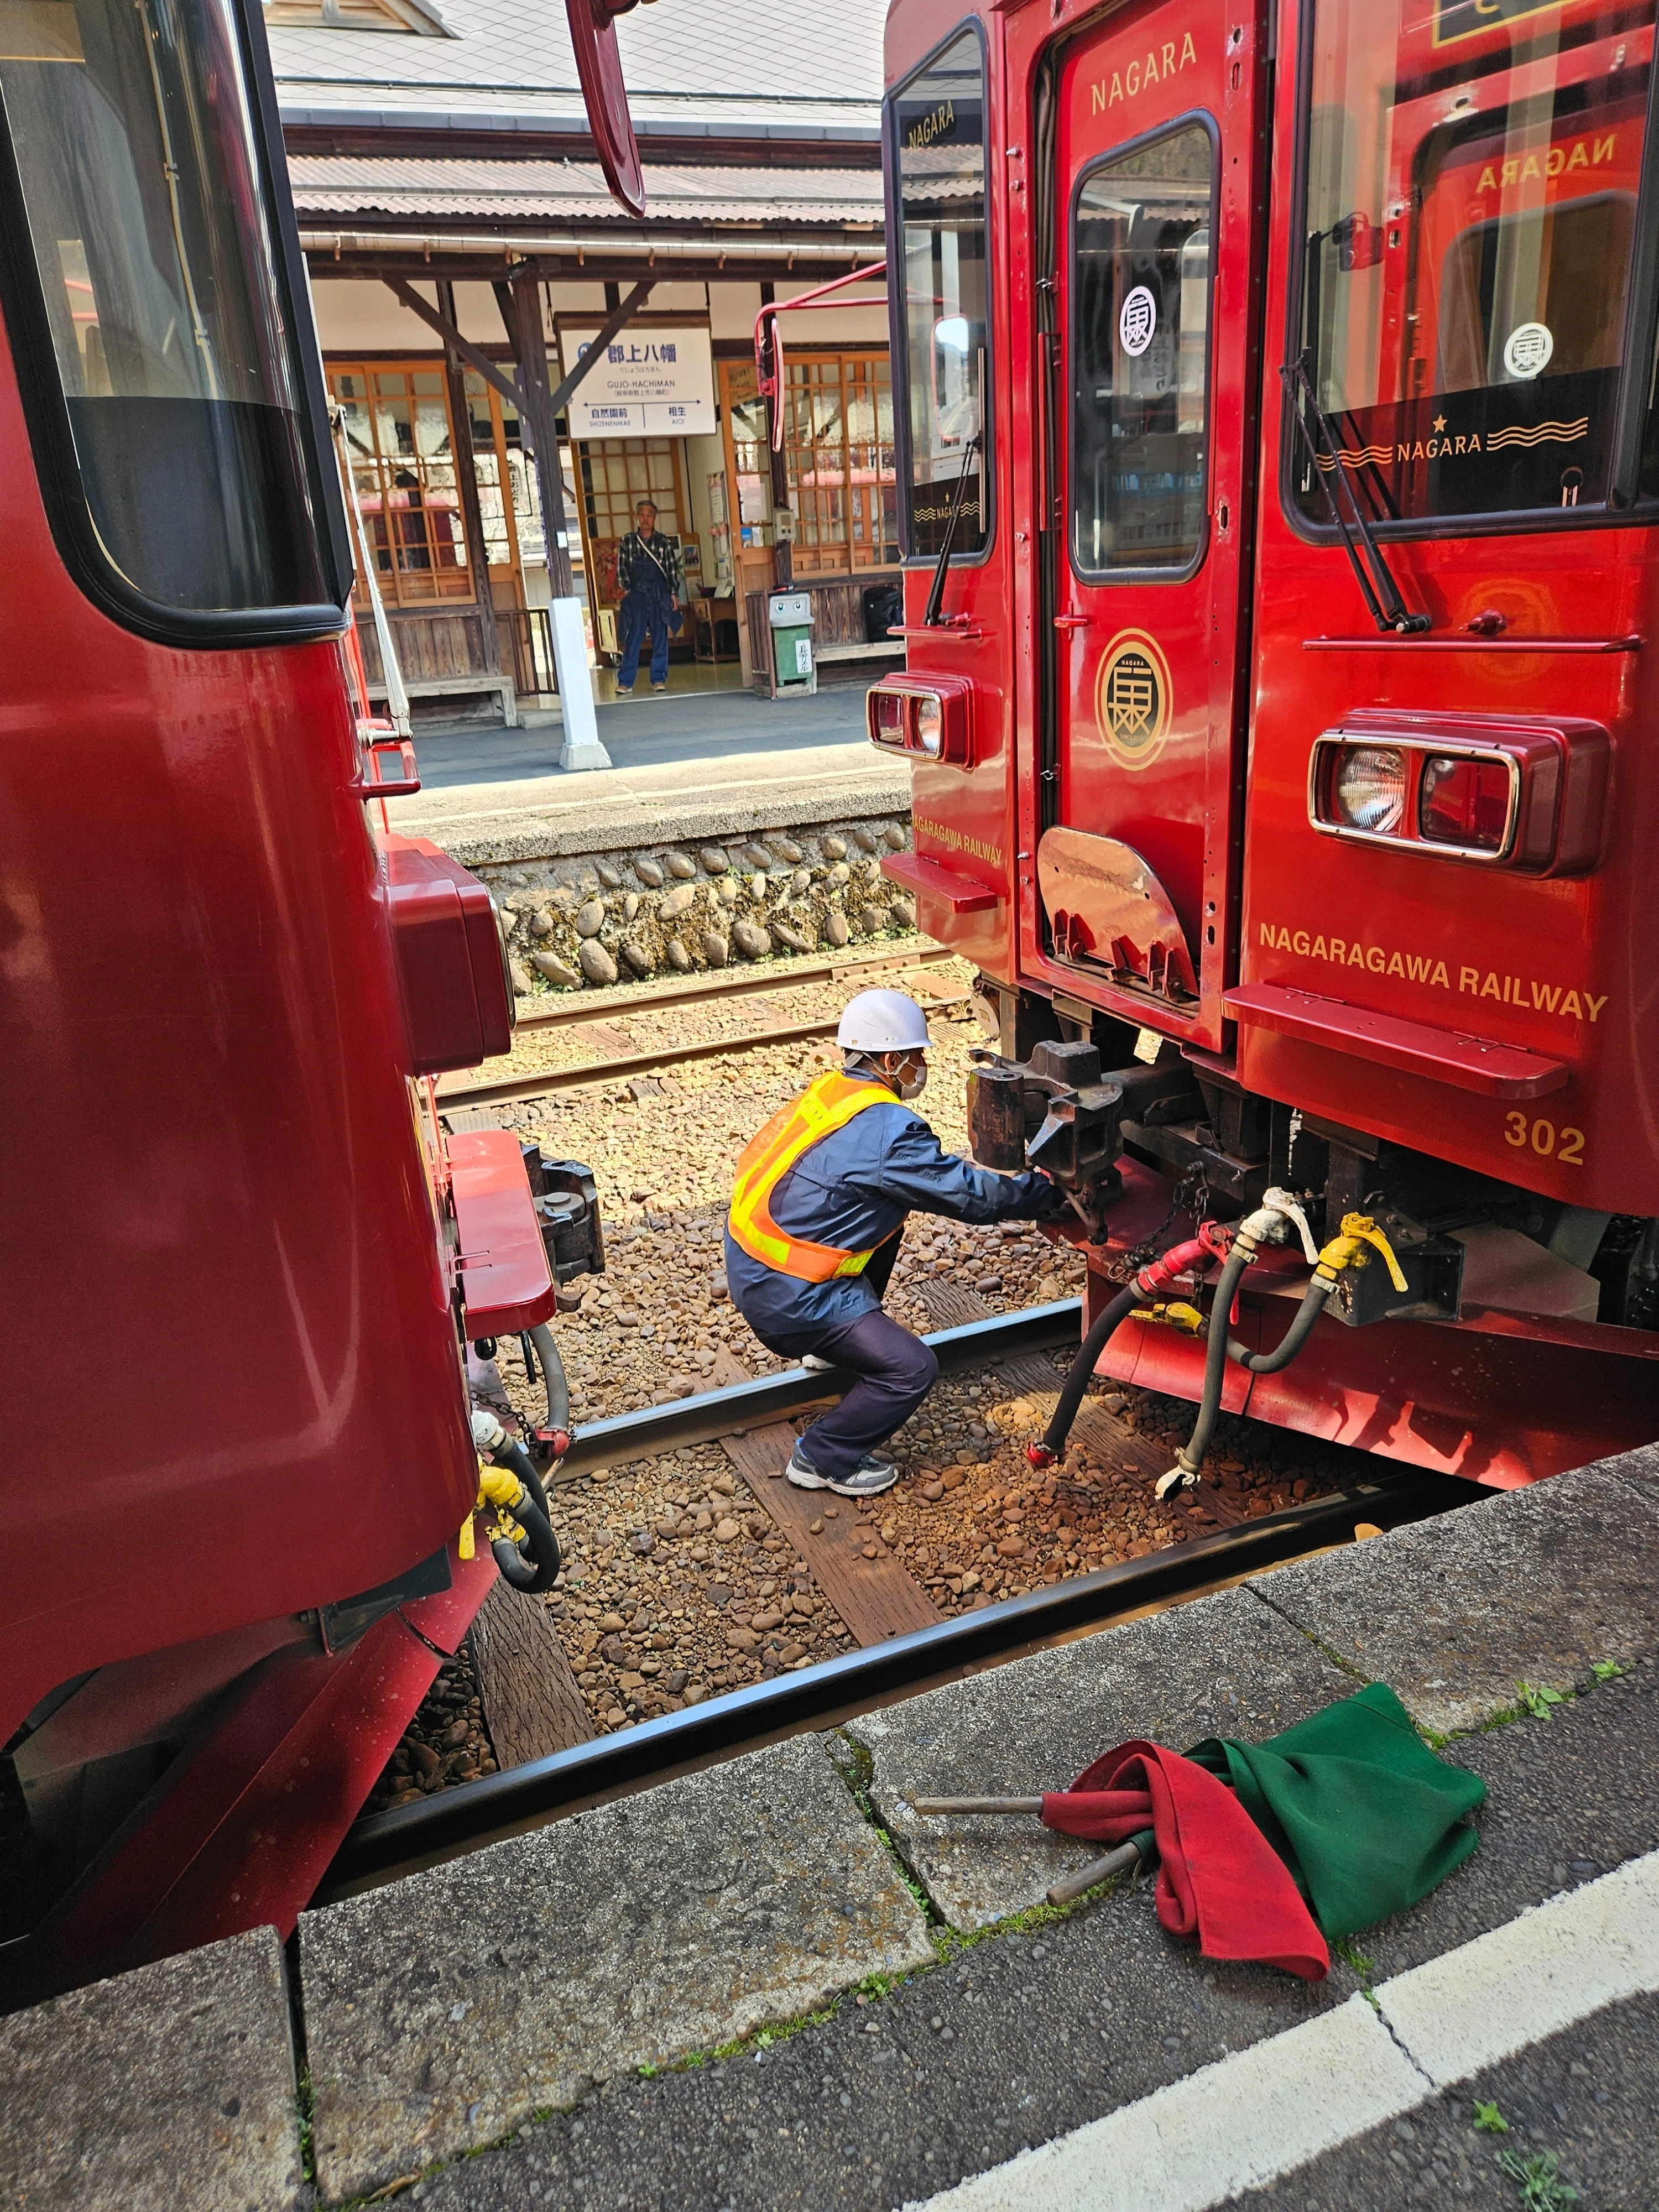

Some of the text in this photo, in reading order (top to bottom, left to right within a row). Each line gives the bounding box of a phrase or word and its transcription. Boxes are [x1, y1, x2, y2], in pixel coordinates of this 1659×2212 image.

[1091, 32, 1197, 116] NAGARA
[909, 100, 954, 150] NAGARA
[608, 343, 676, 363] 郡上八幡
[669, 406, 686, 417] 相生
[1397, 433, 1482, 462] NAGARA
[964, 835, 1001, 865] RAILWAY
[1260, 923, 1609, 1022] NAGARAGAWA RAILWAY
[1504, 1111, 1585, 1166] 302
